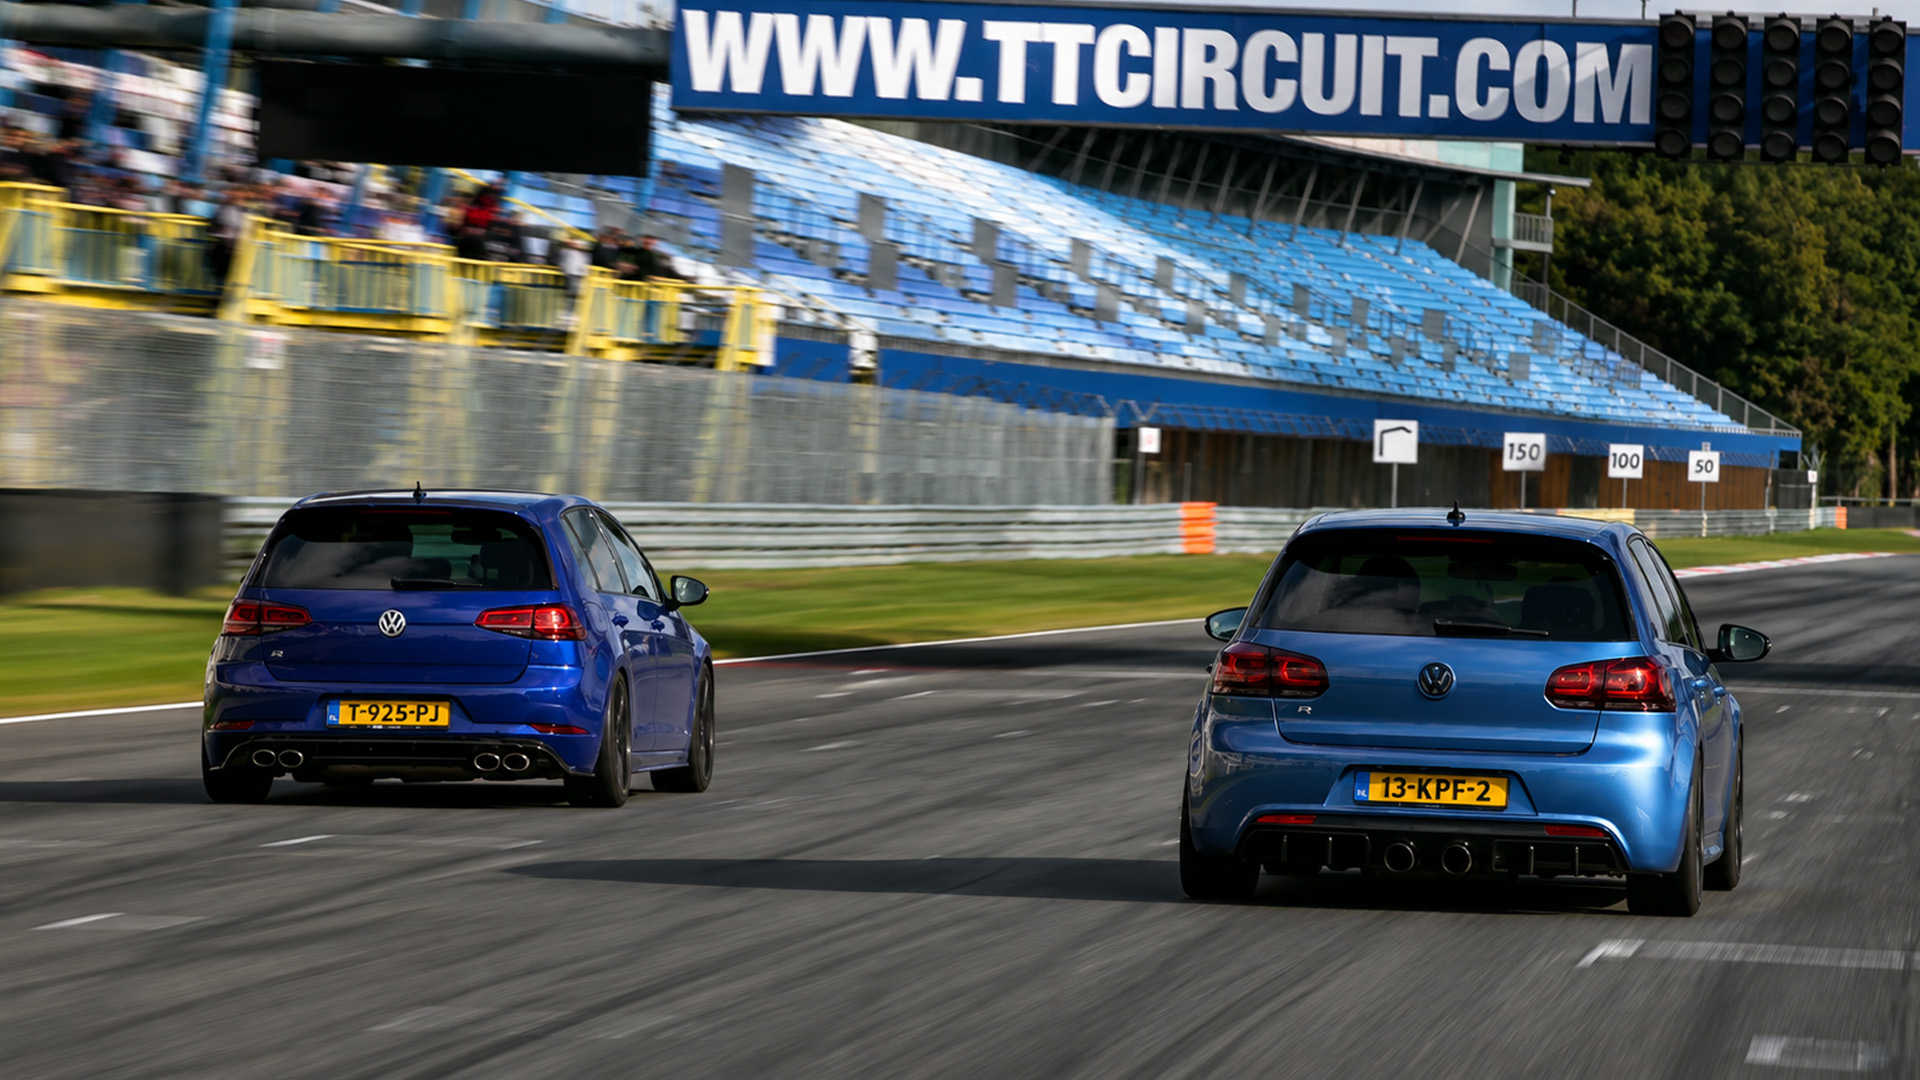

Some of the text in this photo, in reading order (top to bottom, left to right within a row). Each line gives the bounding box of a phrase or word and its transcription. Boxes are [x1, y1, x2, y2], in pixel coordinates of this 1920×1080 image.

[682, 9, 1653, 125] WWW.TTCIRCUIT.COM
[1507, 443, 1541, 461] 150
[1611, 452, 1640, 469] 100
[1694, 459, 1714, 474] 50
[347, 704, 440, 722] T-925-PJ
[1297, 705, 1313, 715] R
[1356, 776, 1491, 802] NL 13-KPF-2
